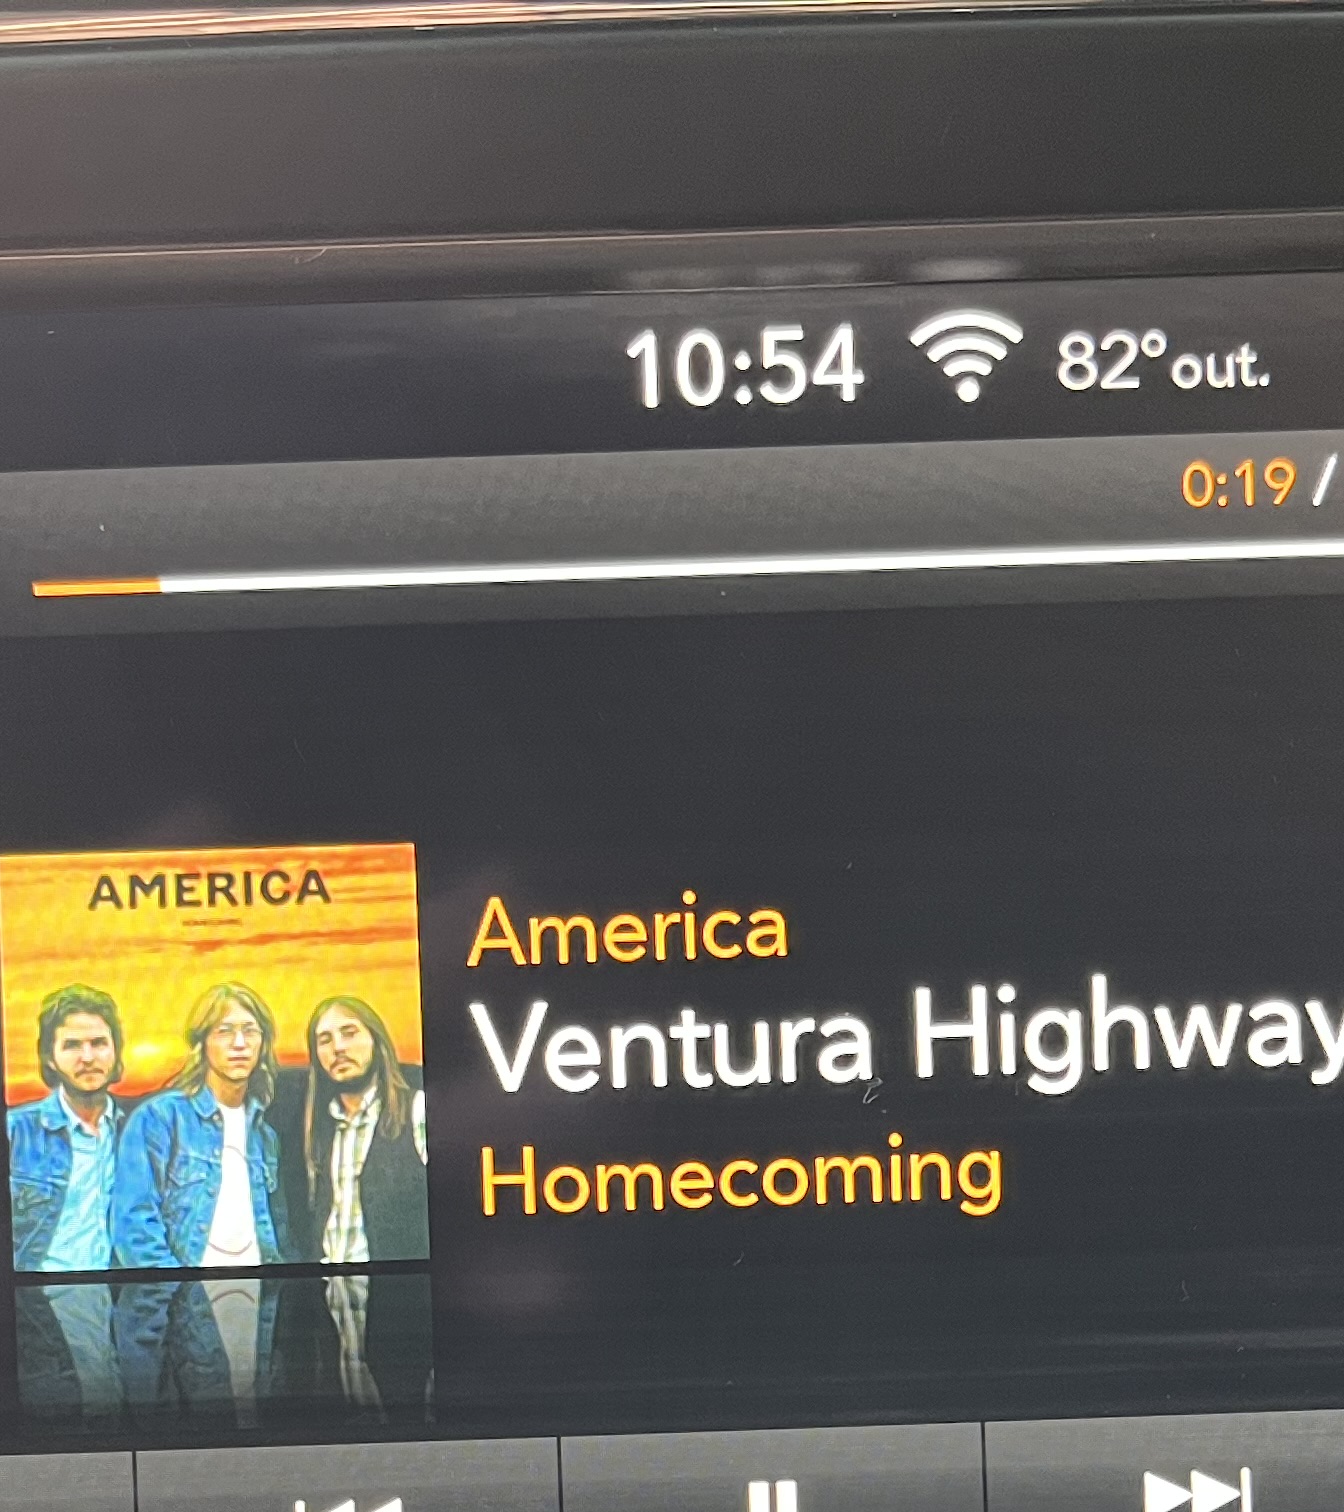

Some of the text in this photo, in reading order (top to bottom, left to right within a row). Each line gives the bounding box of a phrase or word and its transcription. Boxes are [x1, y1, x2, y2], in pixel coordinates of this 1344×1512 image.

[626, 322, 865, 409] 10:54
[1182, 458, 1297, 508] 0:19
[87, 869, 332, 911] AMERICA
[466, 889, 788, 967] America
[468, 999, 873, 1093] Ventura
[480, 1132, 1002, 1217] Homecoming
